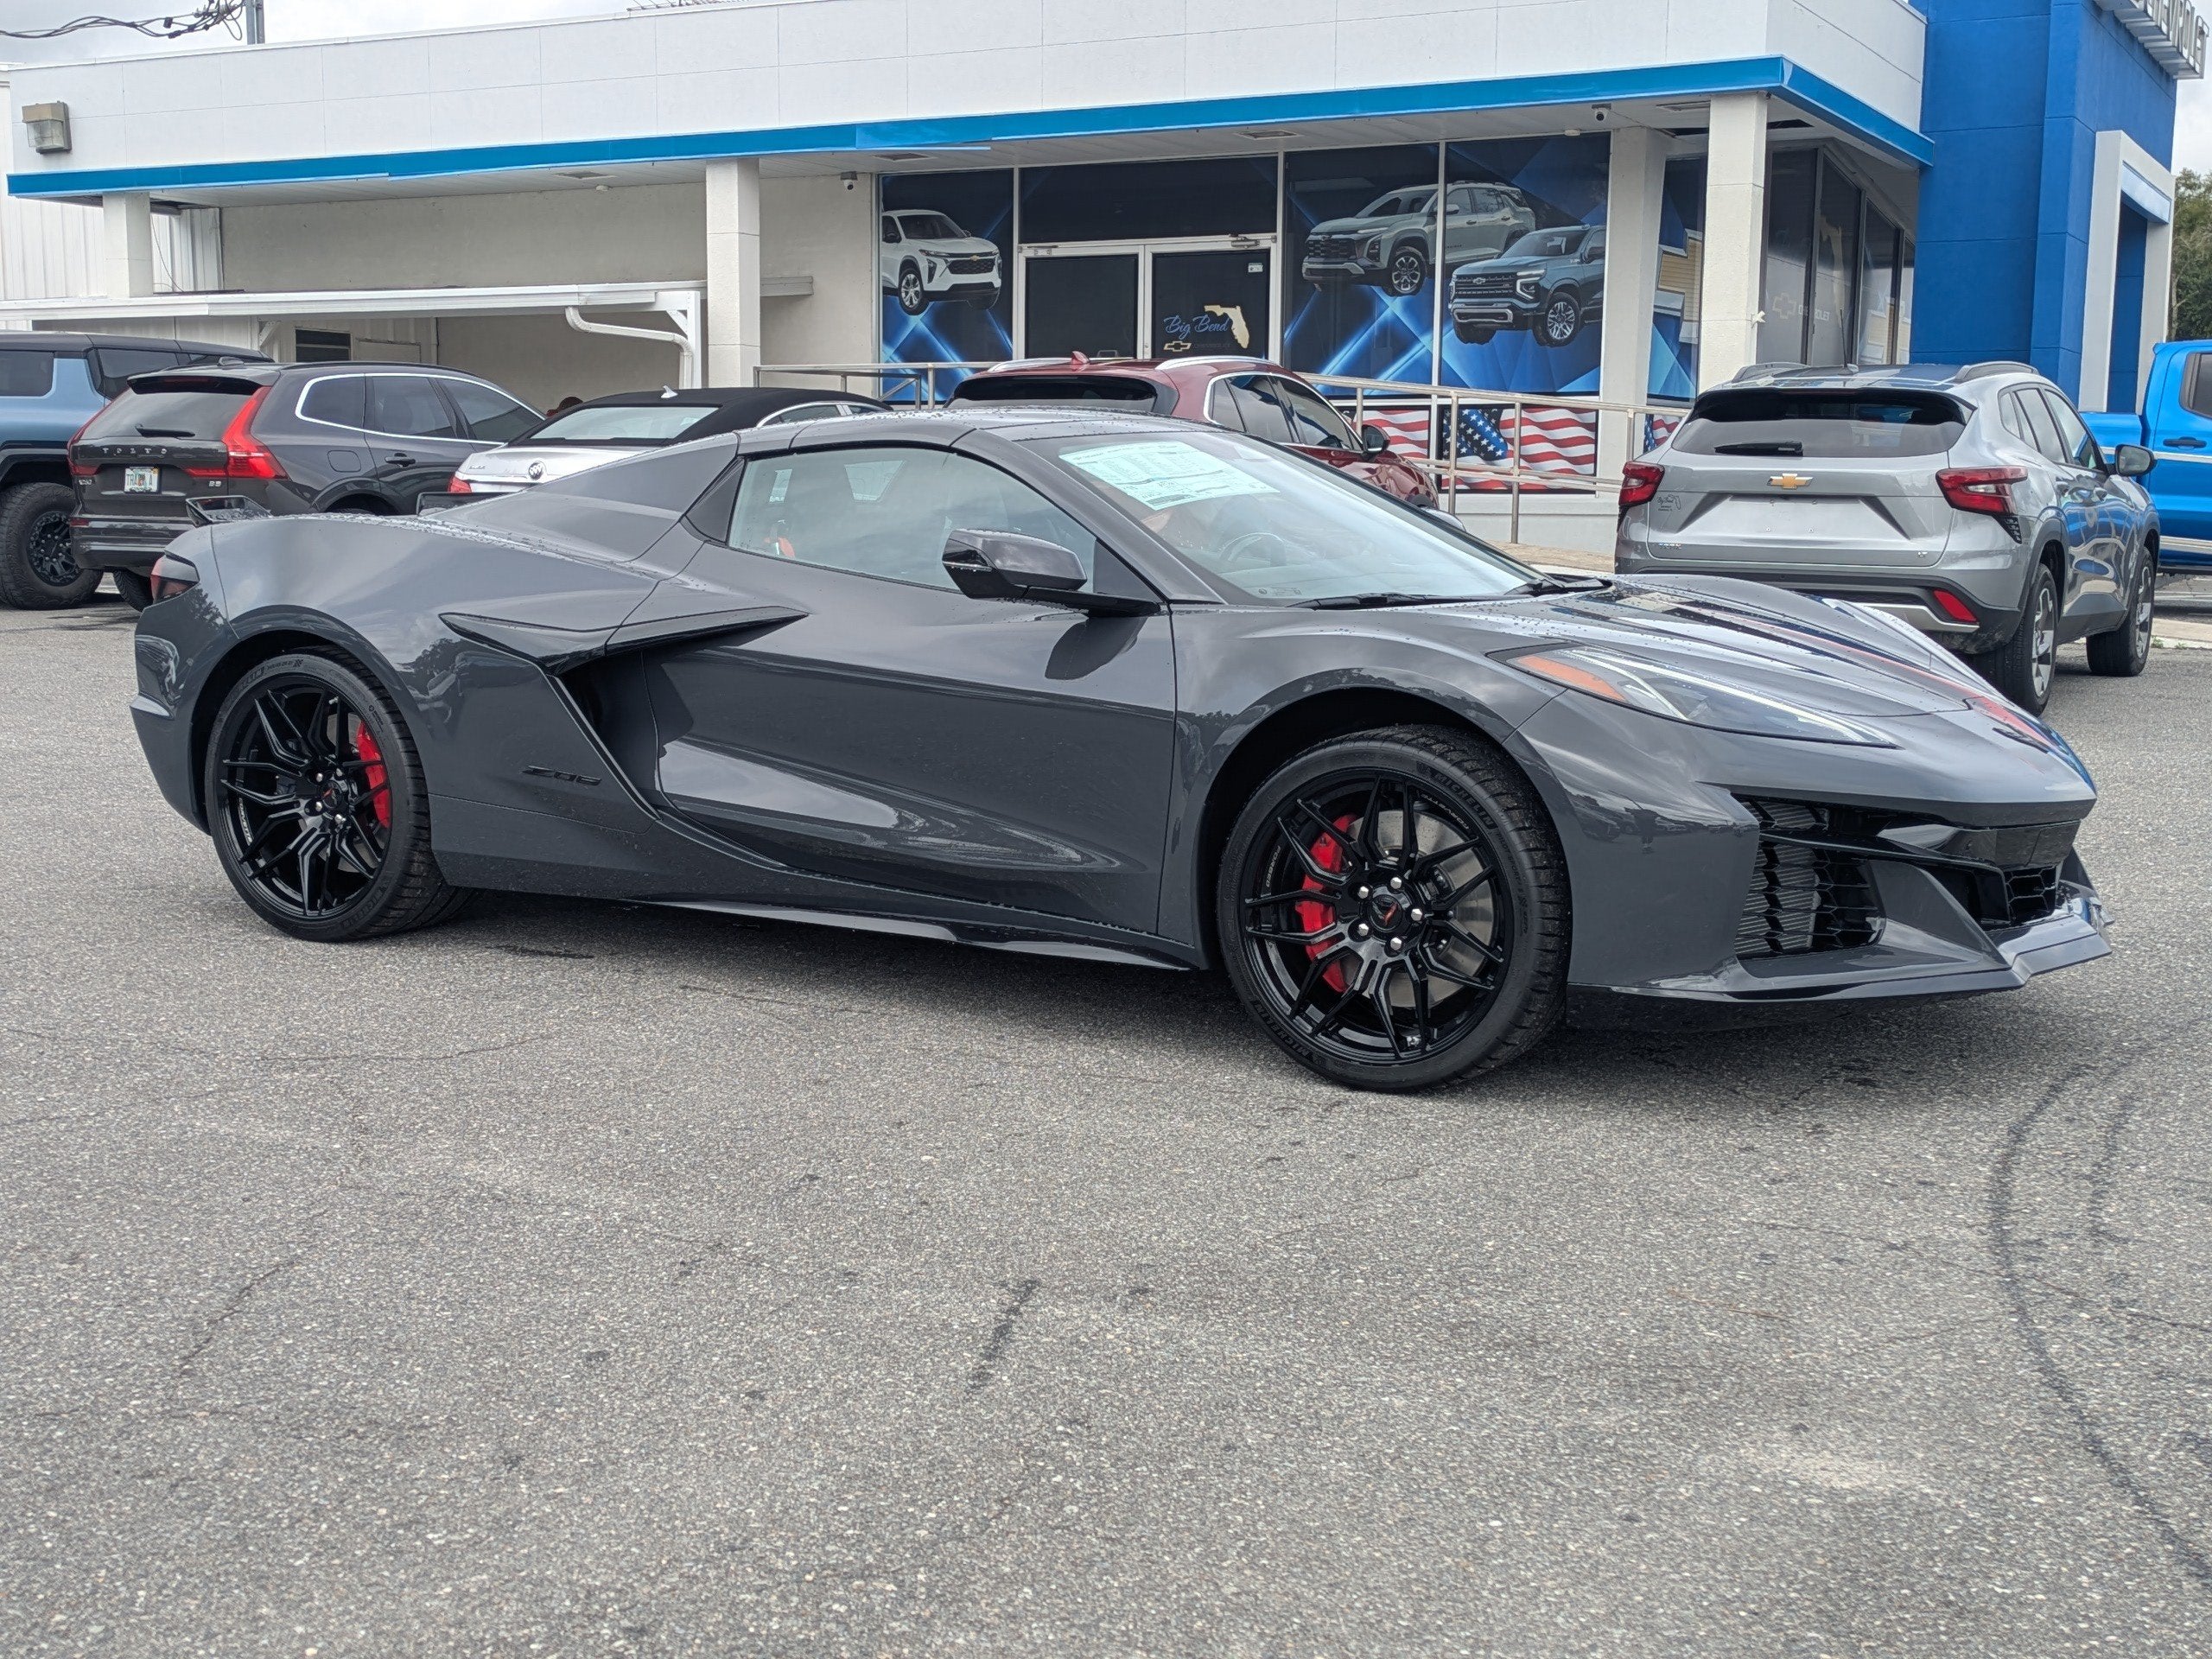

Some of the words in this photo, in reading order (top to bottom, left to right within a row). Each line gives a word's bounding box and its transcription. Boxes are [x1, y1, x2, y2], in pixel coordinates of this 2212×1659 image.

[1163, 315, 1191, 340] Big
[1192, 315, 1230, 333] Bend
[1433, 767, 1499, 830] MICHELIN
[1265, 845, 1281, 887] FORGED
